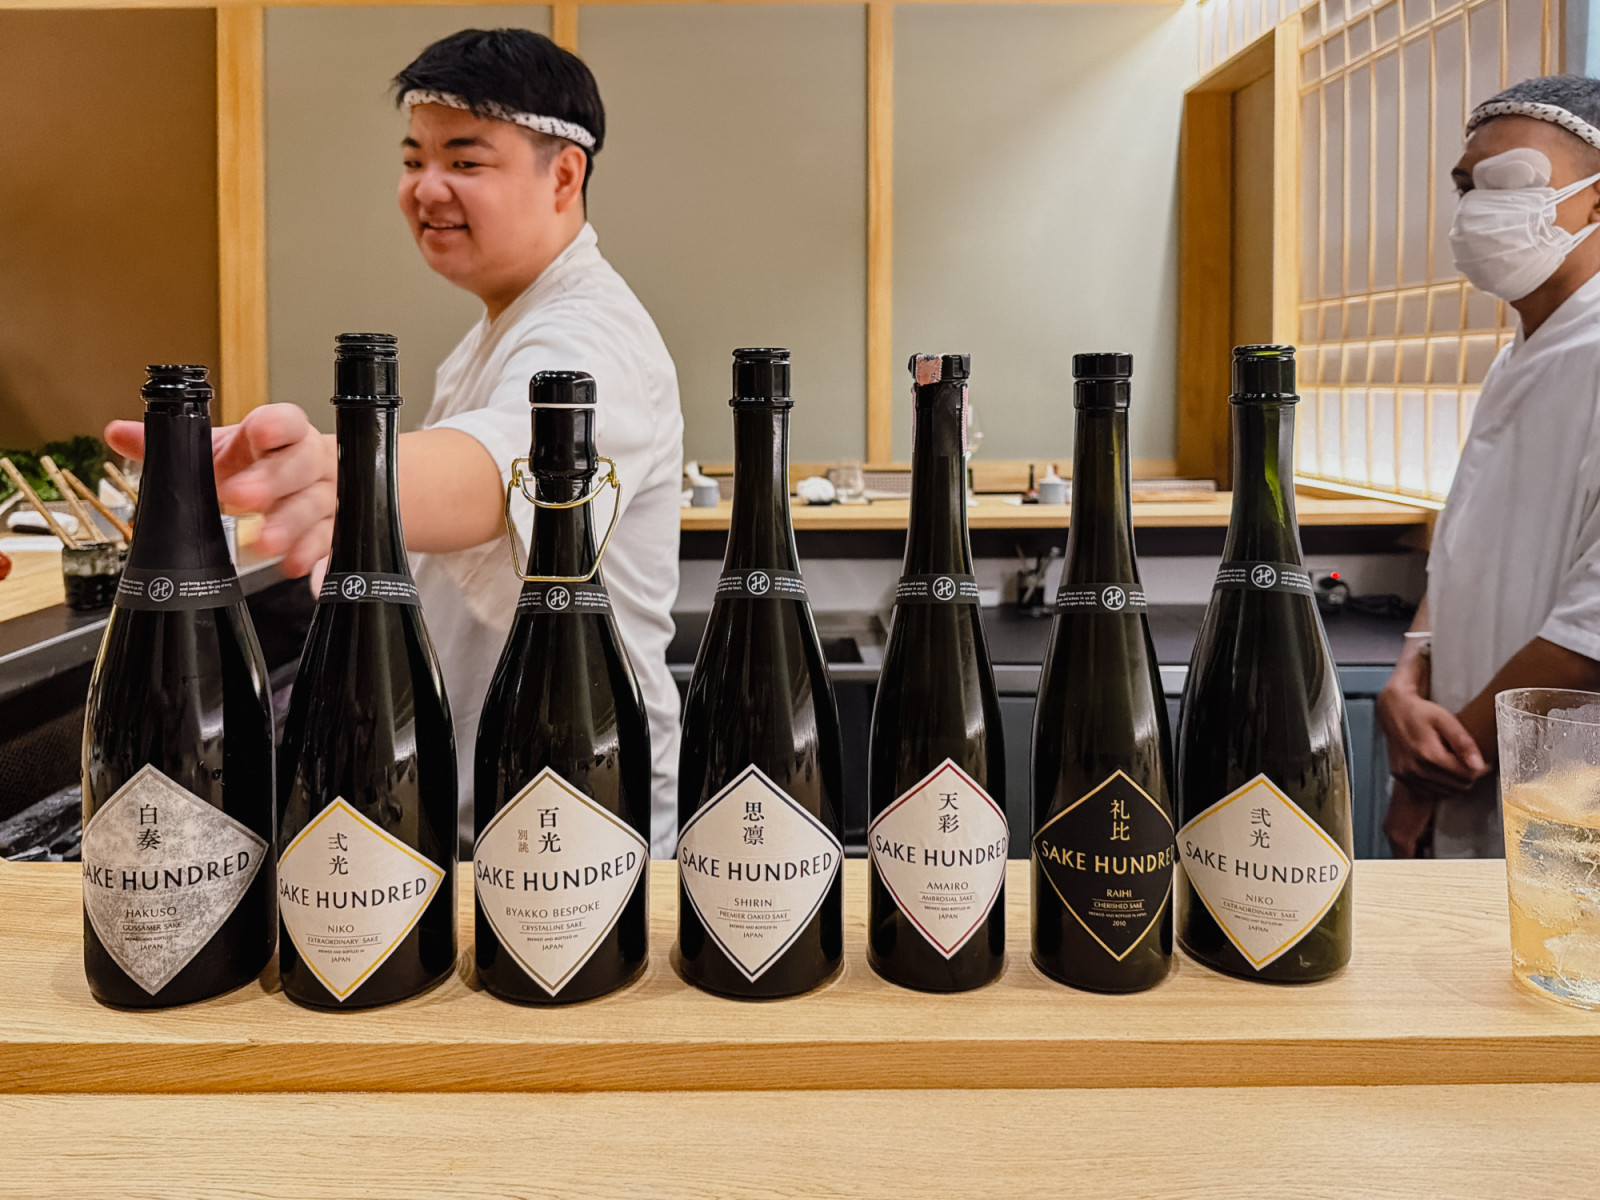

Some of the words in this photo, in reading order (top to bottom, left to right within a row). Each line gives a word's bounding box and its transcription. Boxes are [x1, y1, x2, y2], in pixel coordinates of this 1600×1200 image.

[137, 803, 161, 851] 白奏
[938, 792, 959, 834] 天彩
[1110, 799, 1130, 841] 礼比
[537, 807, 561, 854] 百光
[682, 847, 720, 878] SAKE
[728, 852, 832, 882] HUNDRED
[875, 835, 916, 863] SAKE
[924, 837, 1006, 867] HUNDRED
[1041, 840, 1086, 870] SAKE
[1185, 841, 1227, 872] SAKE
[1235, 859, 1338, 884] HUNDRED
[122, 851, 250, 891] HUNDRED
[477, 860, 515, 889] SAKE
[524, 851, 636, 891] HUNDRED
[927, 882, 969, 890] AMAIRO
[280, 878, 309, 906] SAKE
[317, 877, 426, 908] HUNDRED
[734, 898, 772, 907] SHIRIN
[1106, 889, 1132, 897] RAIHI
[1246, 893, 1273, 905] NIKO
[126, 907, 176, 919] HAKUSO
[506, 906, 548, 918] BYAKKO
[553, 901, 600, 917] BESPOKE
[720, 911, 745, 919] PREMIER
[1223, 901, 1277, 917] EXTRAORDINARY
[328, 925, 354, 933] NIKO
